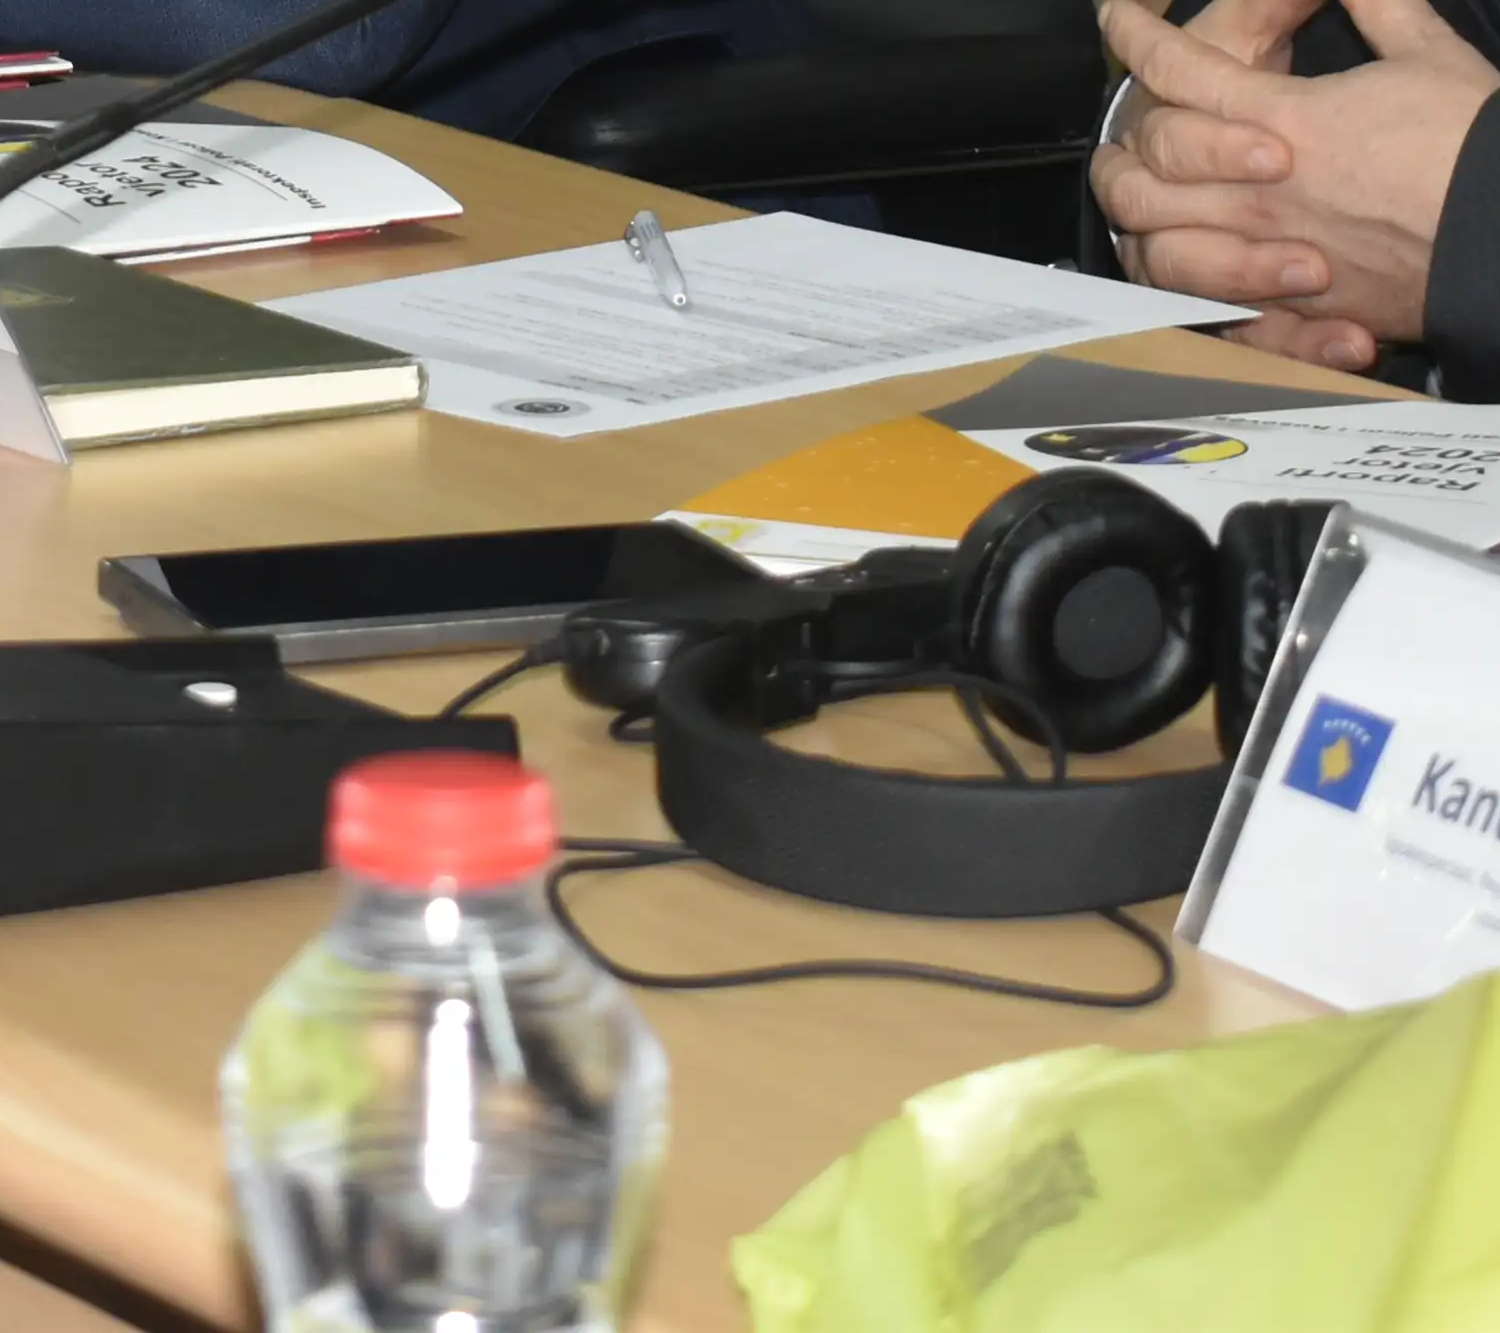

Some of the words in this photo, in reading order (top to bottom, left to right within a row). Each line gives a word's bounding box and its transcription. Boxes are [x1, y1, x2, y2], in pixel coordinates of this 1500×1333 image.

[121, 154, 226, 190] 2024
[1274, 465, 1482, 492] Raporti
[1330, 455, 1487, 477] vjetor
